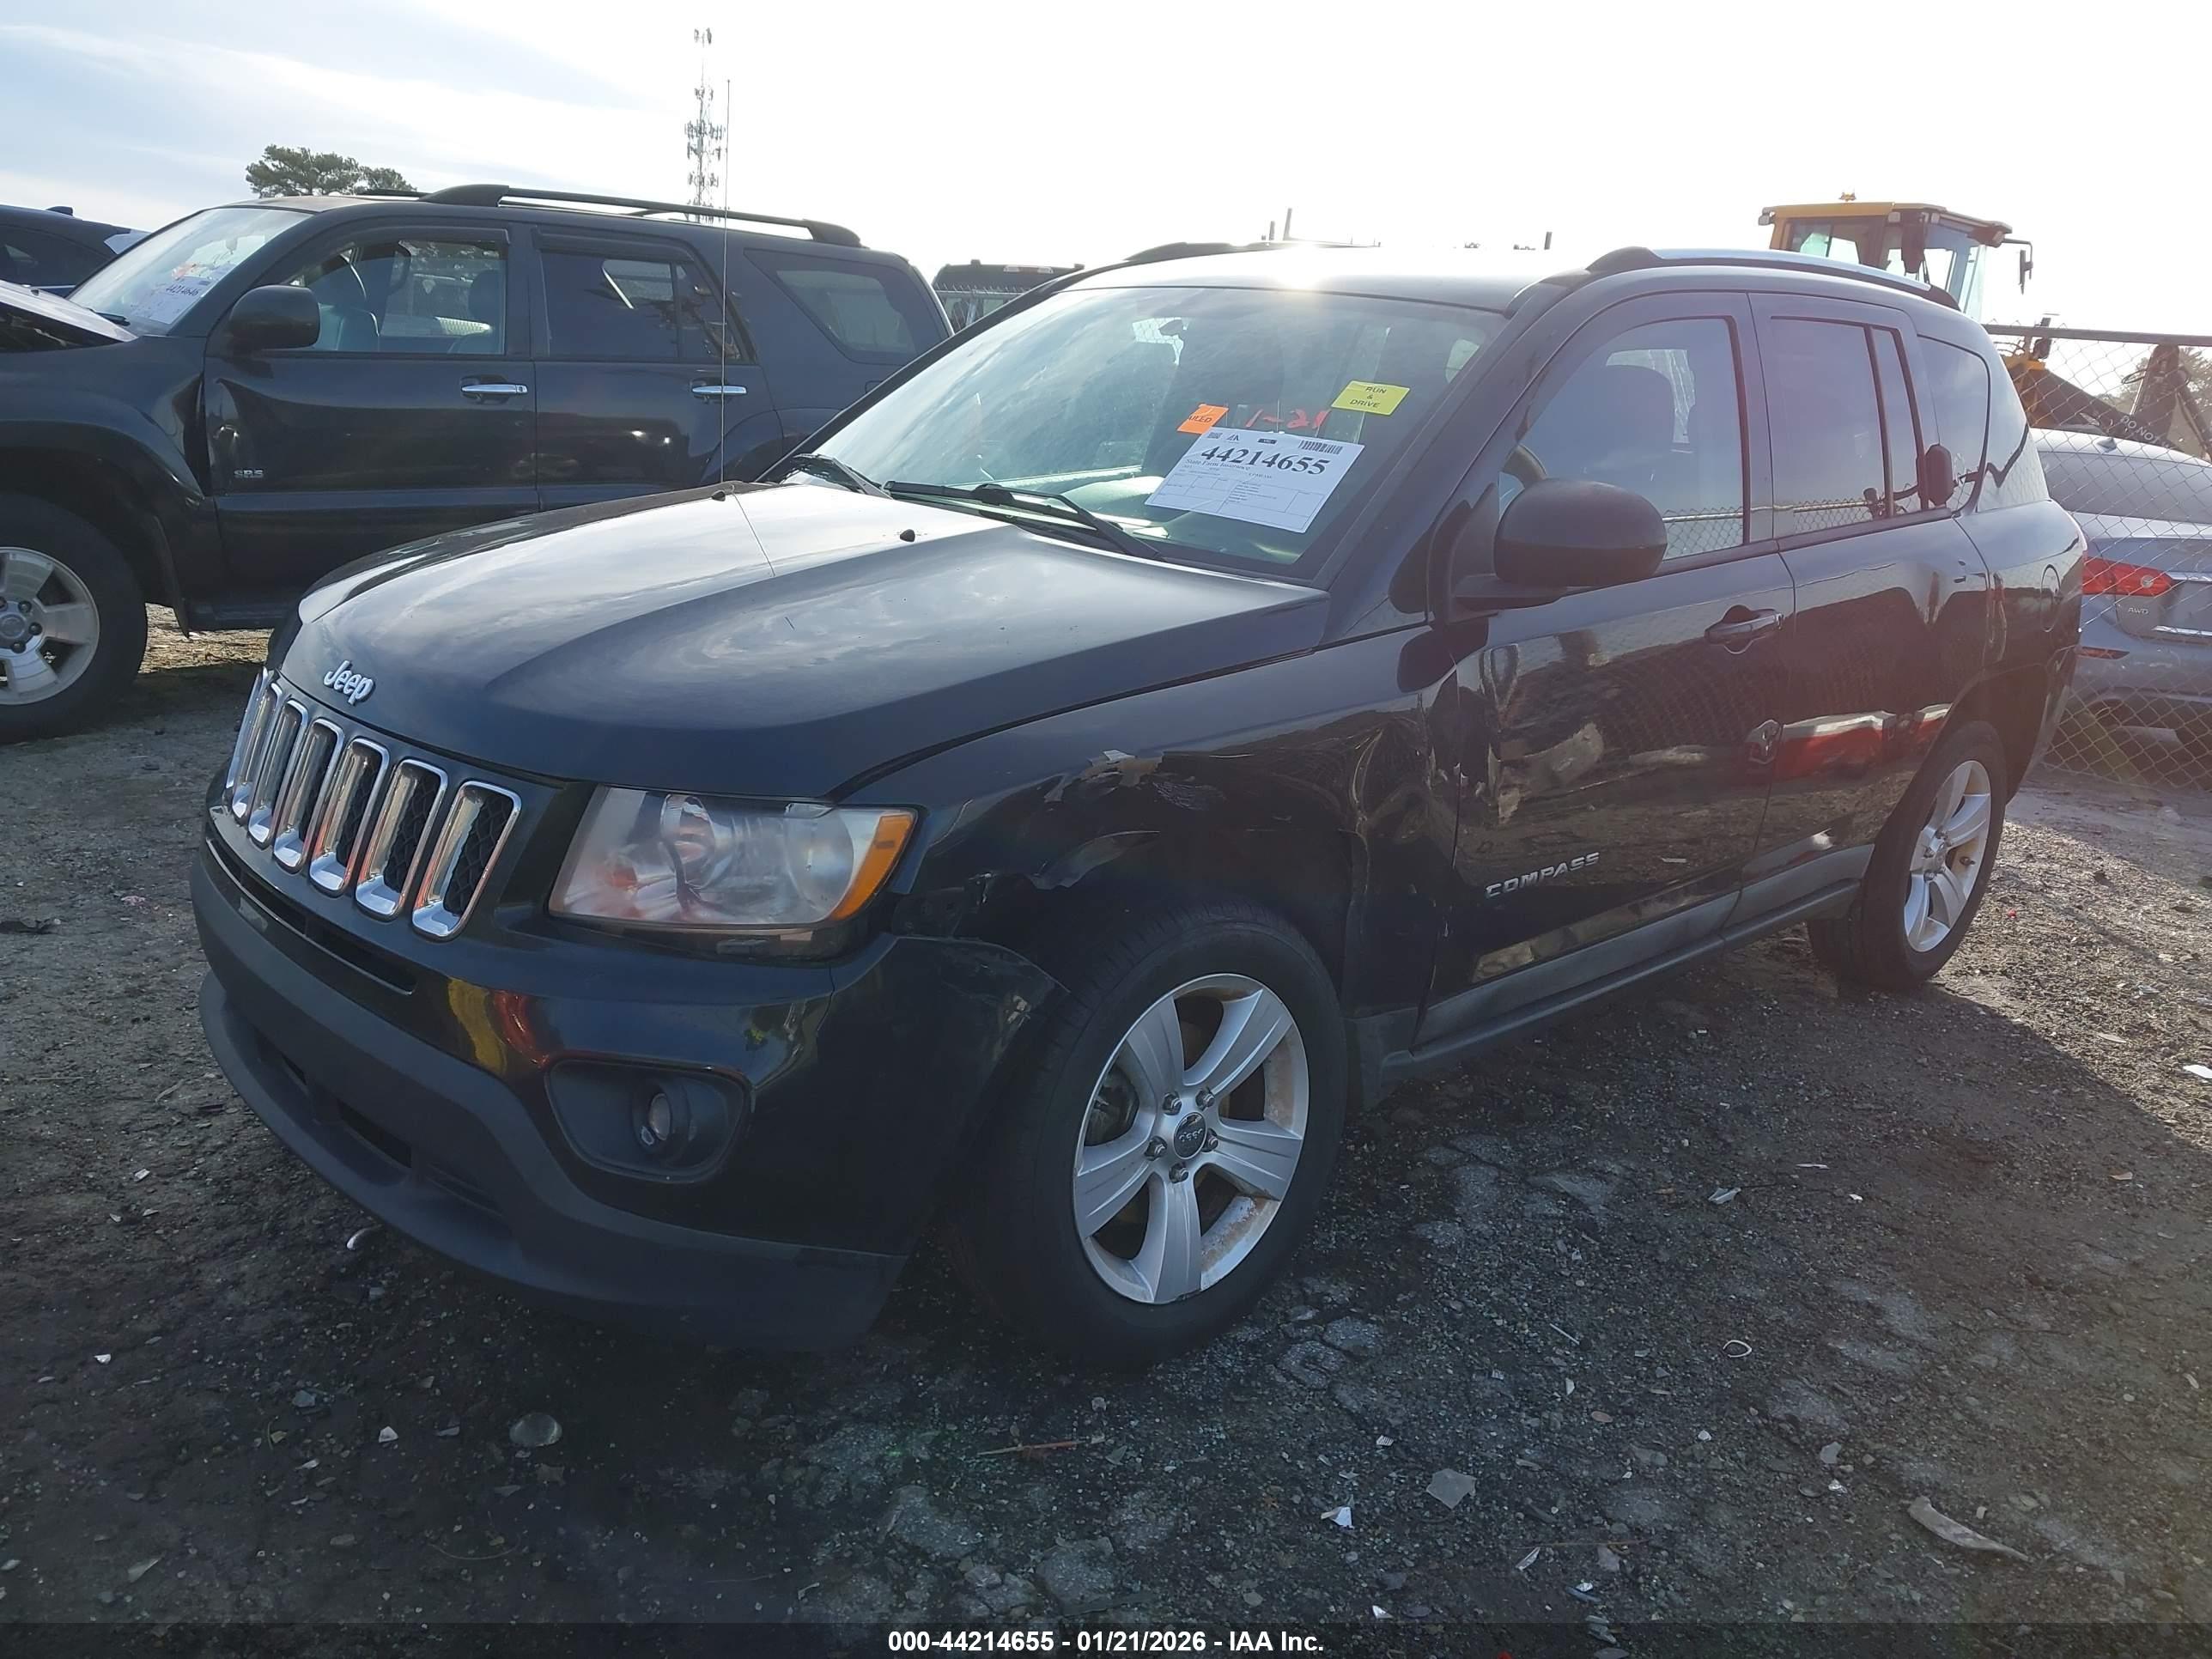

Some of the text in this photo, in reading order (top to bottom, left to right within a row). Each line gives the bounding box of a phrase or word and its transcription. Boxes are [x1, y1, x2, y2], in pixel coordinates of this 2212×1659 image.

[1349, 399, 1381, 408] DRIVE
[1200, 446, 1331, 475] 44214655
[323, 660, 374, 705] Jeep
[1485, 852, 1601, 898] COMPASS
